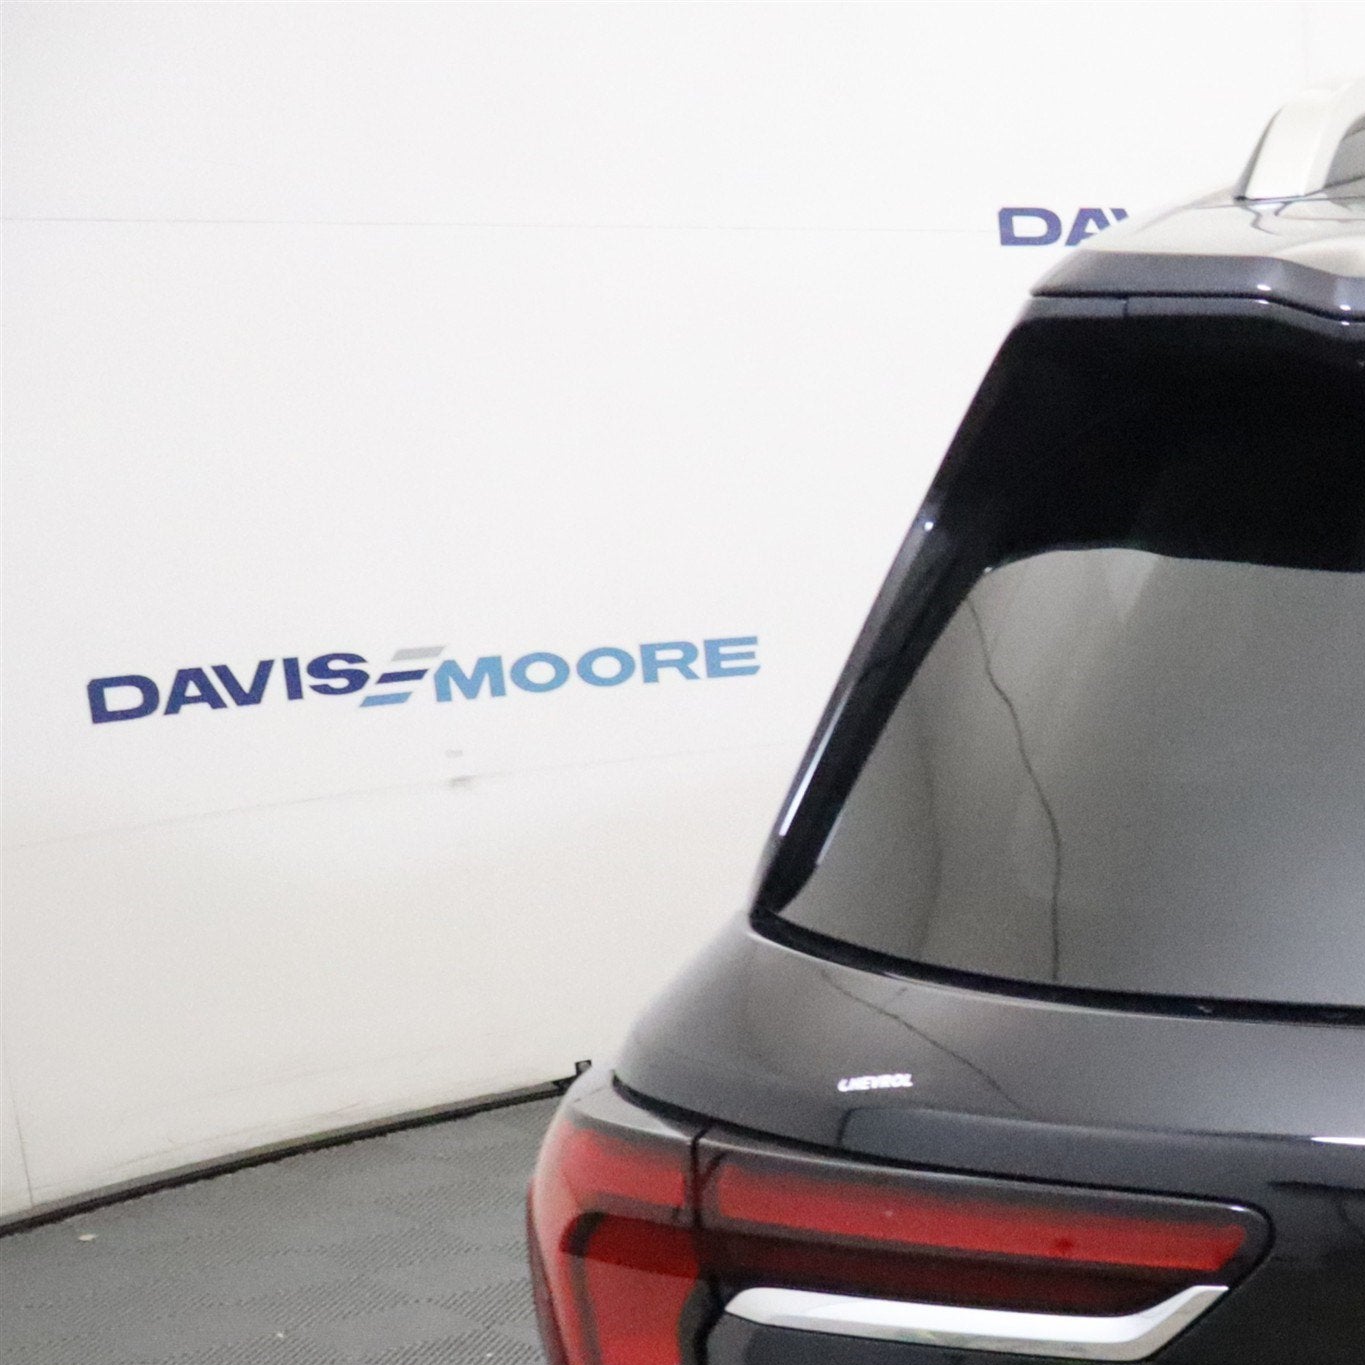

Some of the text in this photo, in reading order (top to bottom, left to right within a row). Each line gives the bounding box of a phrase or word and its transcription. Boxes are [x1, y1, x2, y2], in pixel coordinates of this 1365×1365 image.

[998, 208, 1129, 246] DA
[86, 635, 761, 724] DAVIS MOORE
